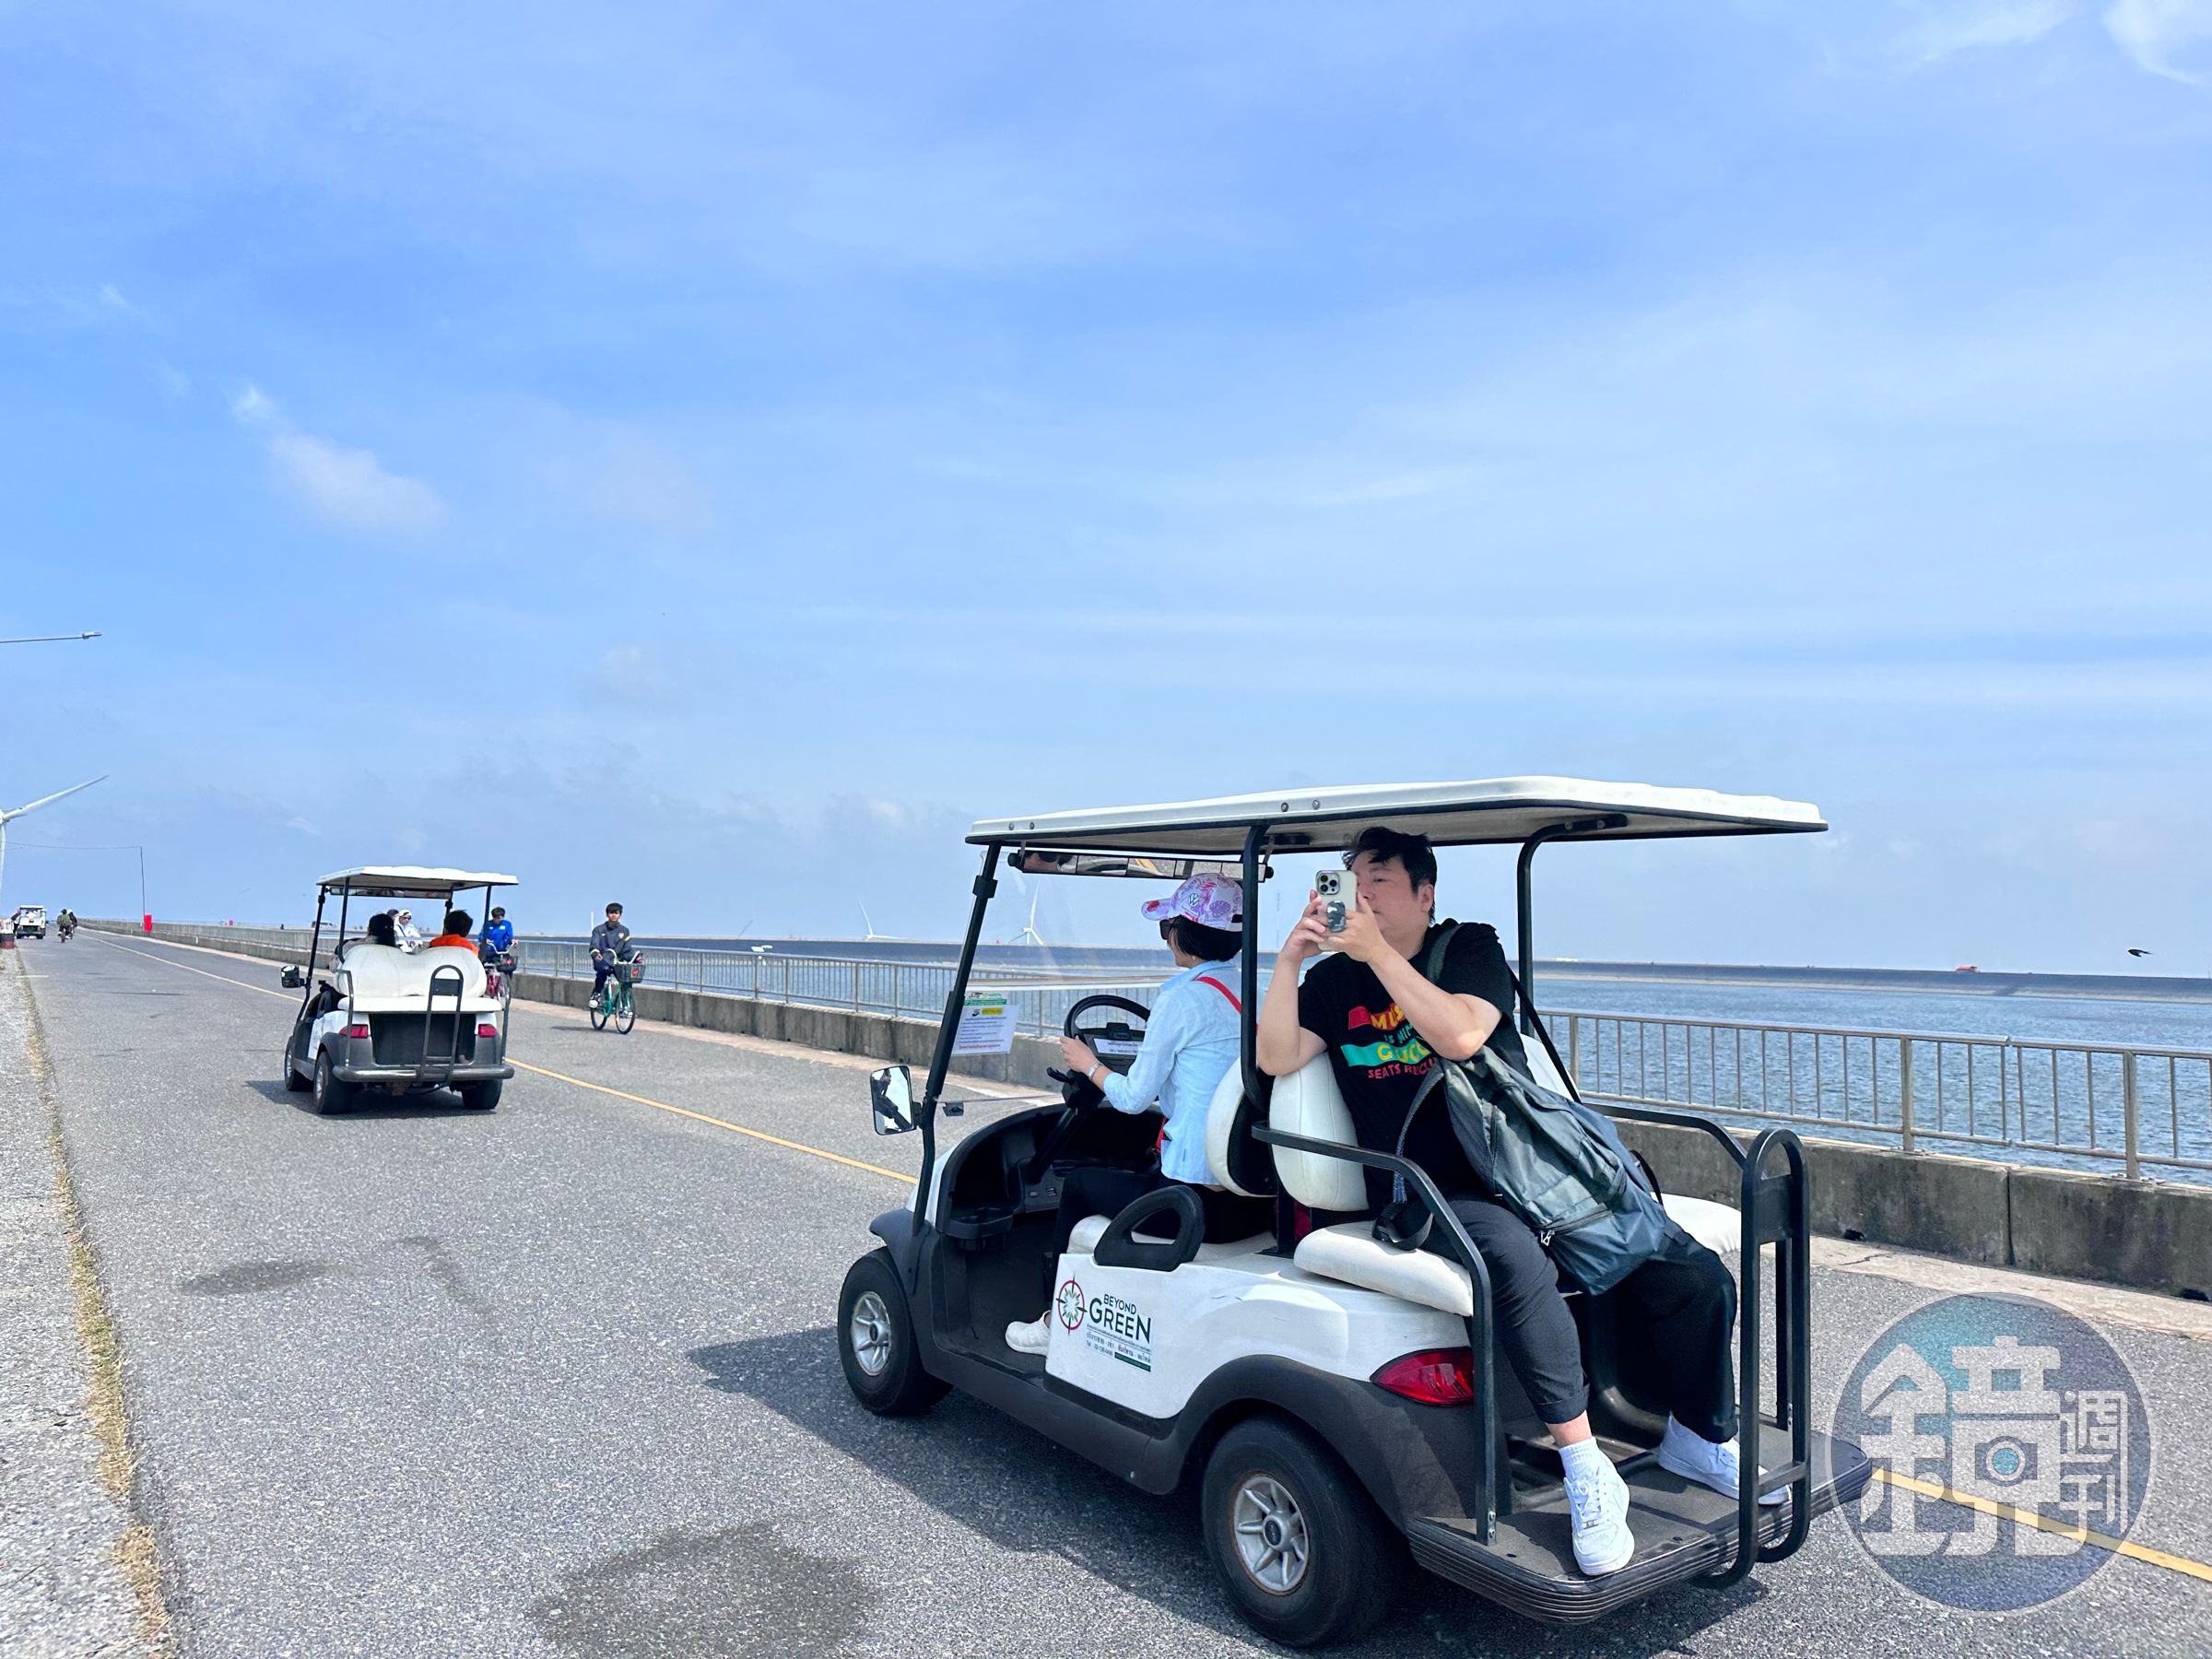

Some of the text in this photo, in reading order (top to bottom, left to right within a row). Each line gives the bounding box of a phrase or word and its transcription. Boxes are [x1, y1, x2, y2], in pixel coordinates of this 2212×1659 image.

[1371, 1005, 1405, 1030] MUS
[1377, 1041, 1430, 1063] GUCC
[1368, 1057, 1435, 1079] SEATS RECLI
[1104, 1294, 1136, 1314] BEYOND
[1089, 1298, 1151, 1344] GREEN
